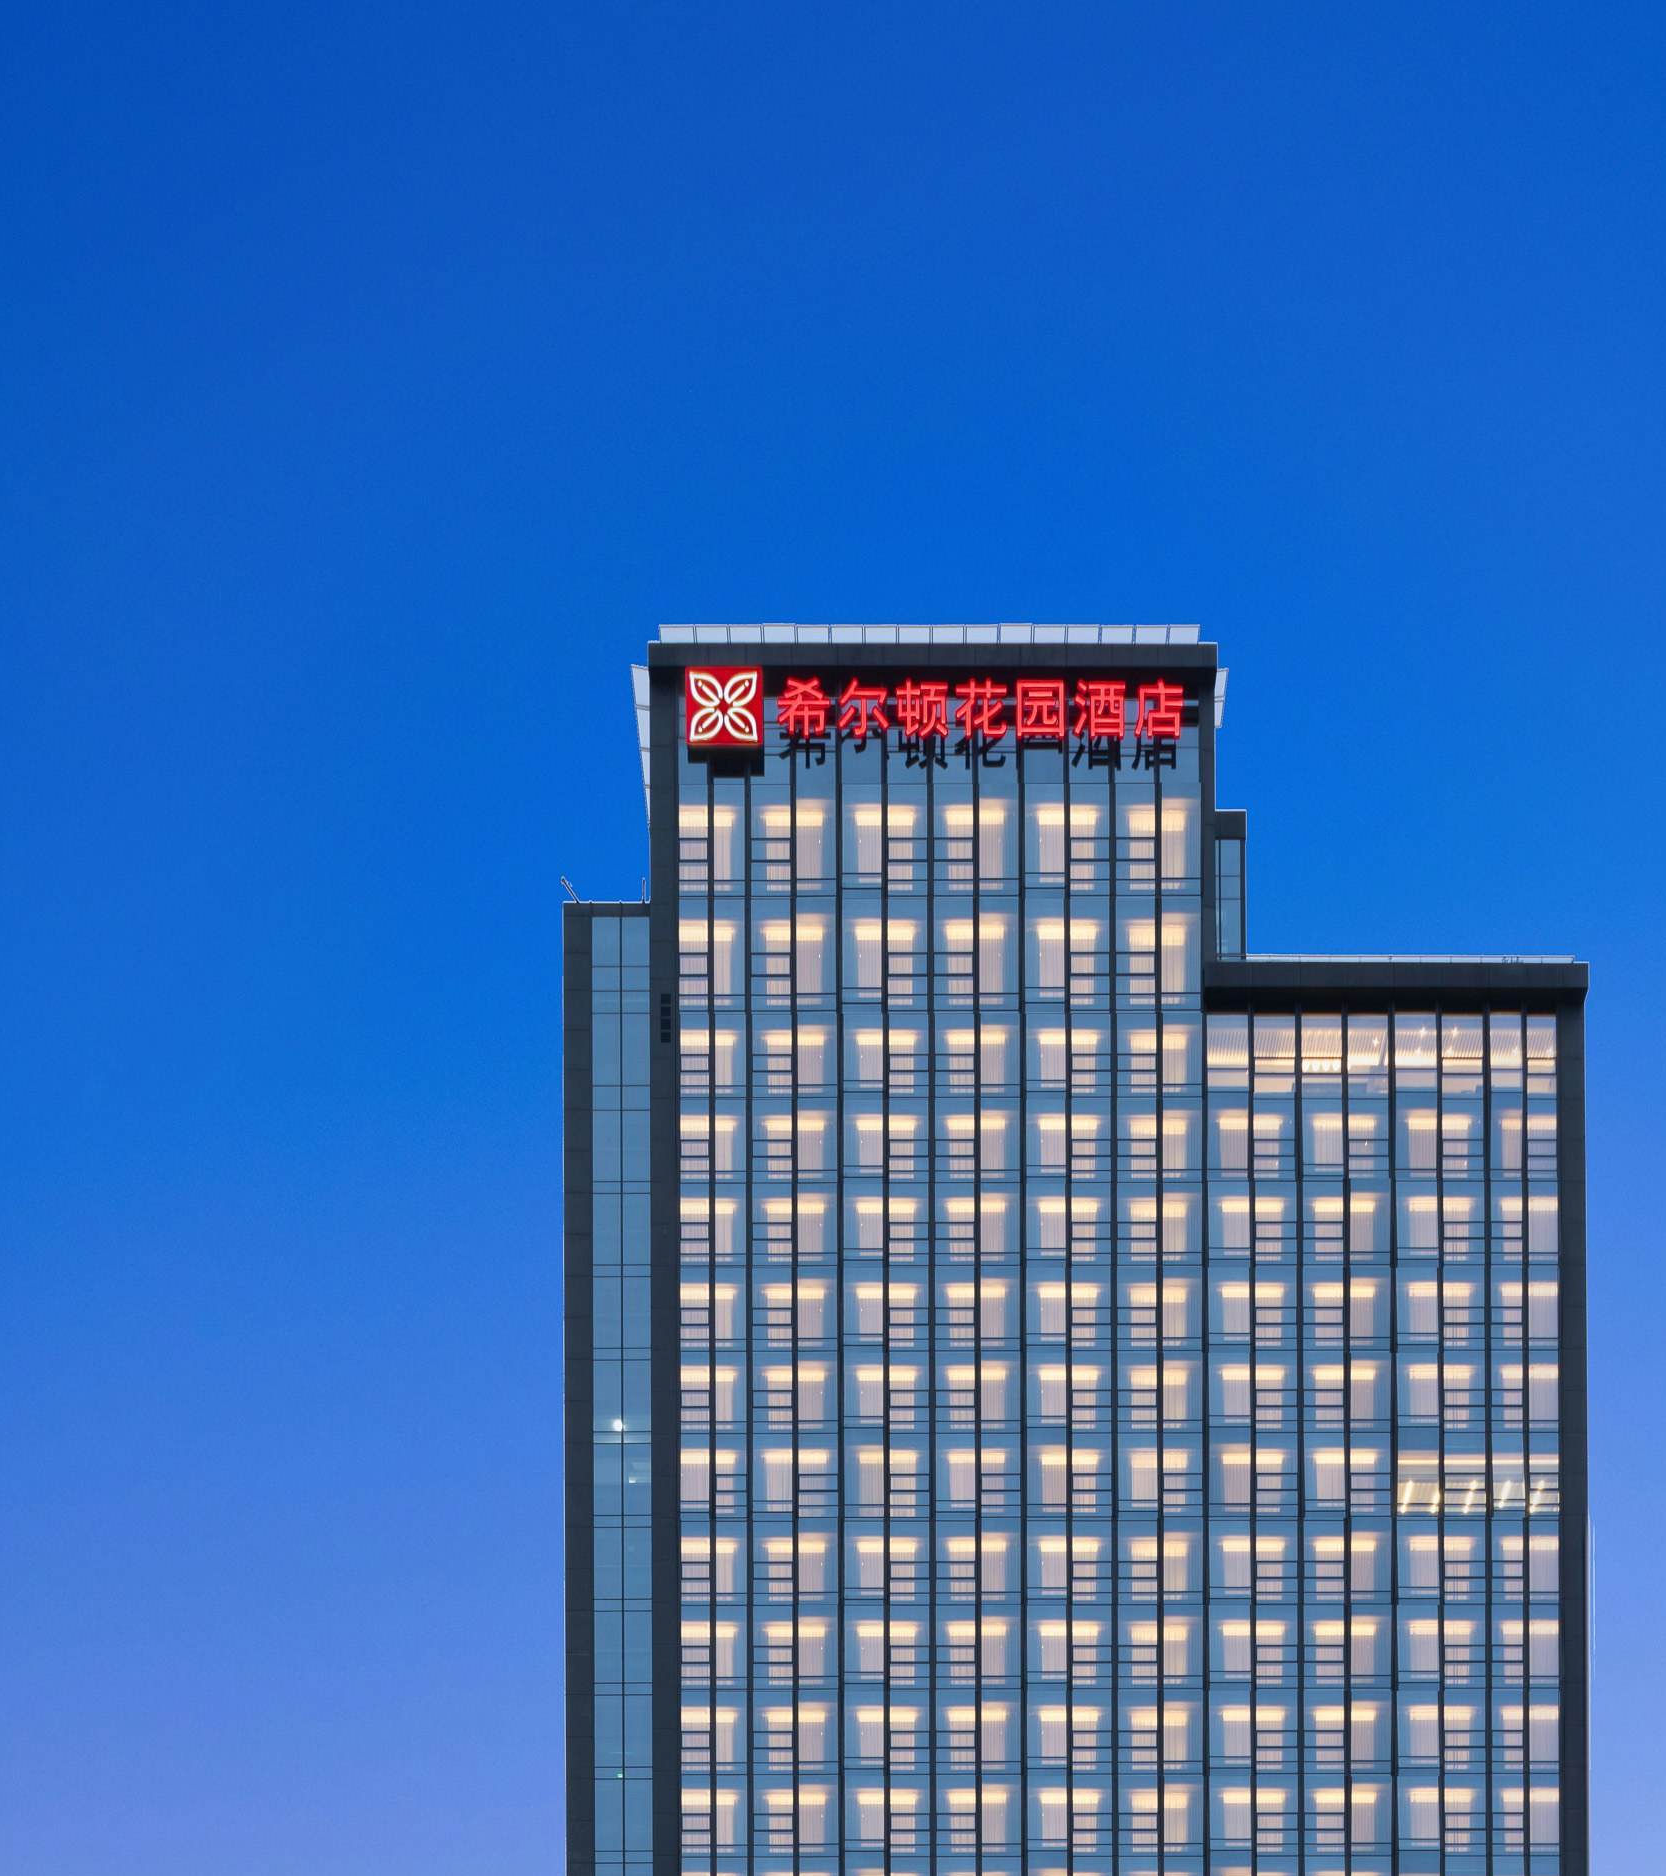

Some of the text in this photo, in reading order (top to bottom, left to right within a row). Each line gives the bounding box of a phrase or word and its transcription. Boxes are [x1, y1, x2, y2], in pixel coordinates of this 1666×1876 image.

[776, 677, 1185, 739] 希尔顿花园酒店
